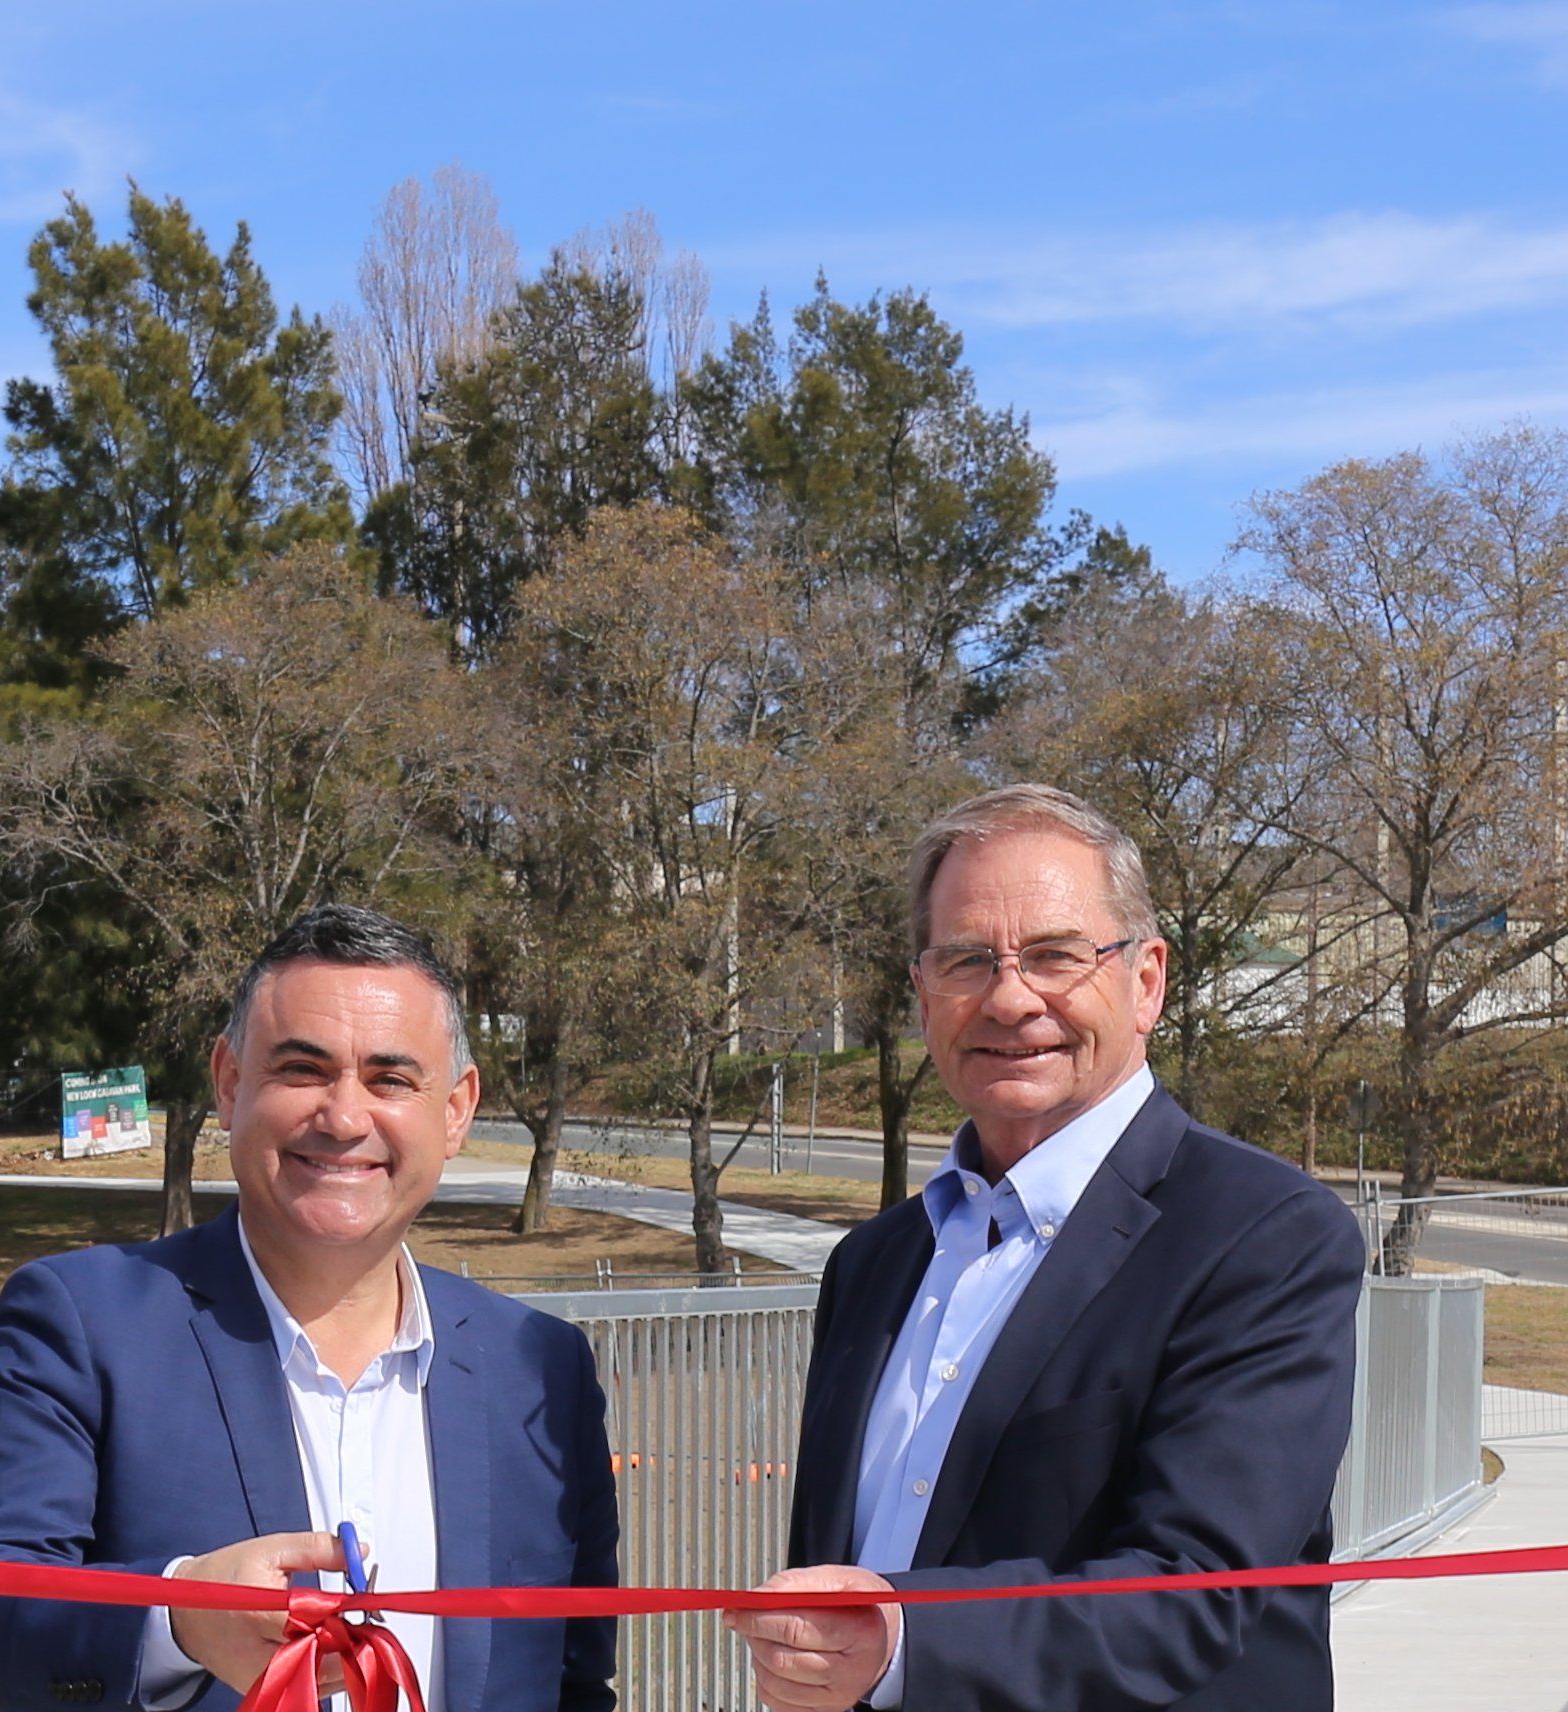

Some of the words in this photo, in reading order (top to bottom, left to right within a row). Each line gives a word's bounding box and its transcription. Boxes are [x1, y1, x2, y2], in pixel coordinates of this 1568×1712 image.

[65, 1091, 79, 1102] NEW
[80, 1088, 96, 1100] LOOK
[124, 1083, 141, 1094] PARK
